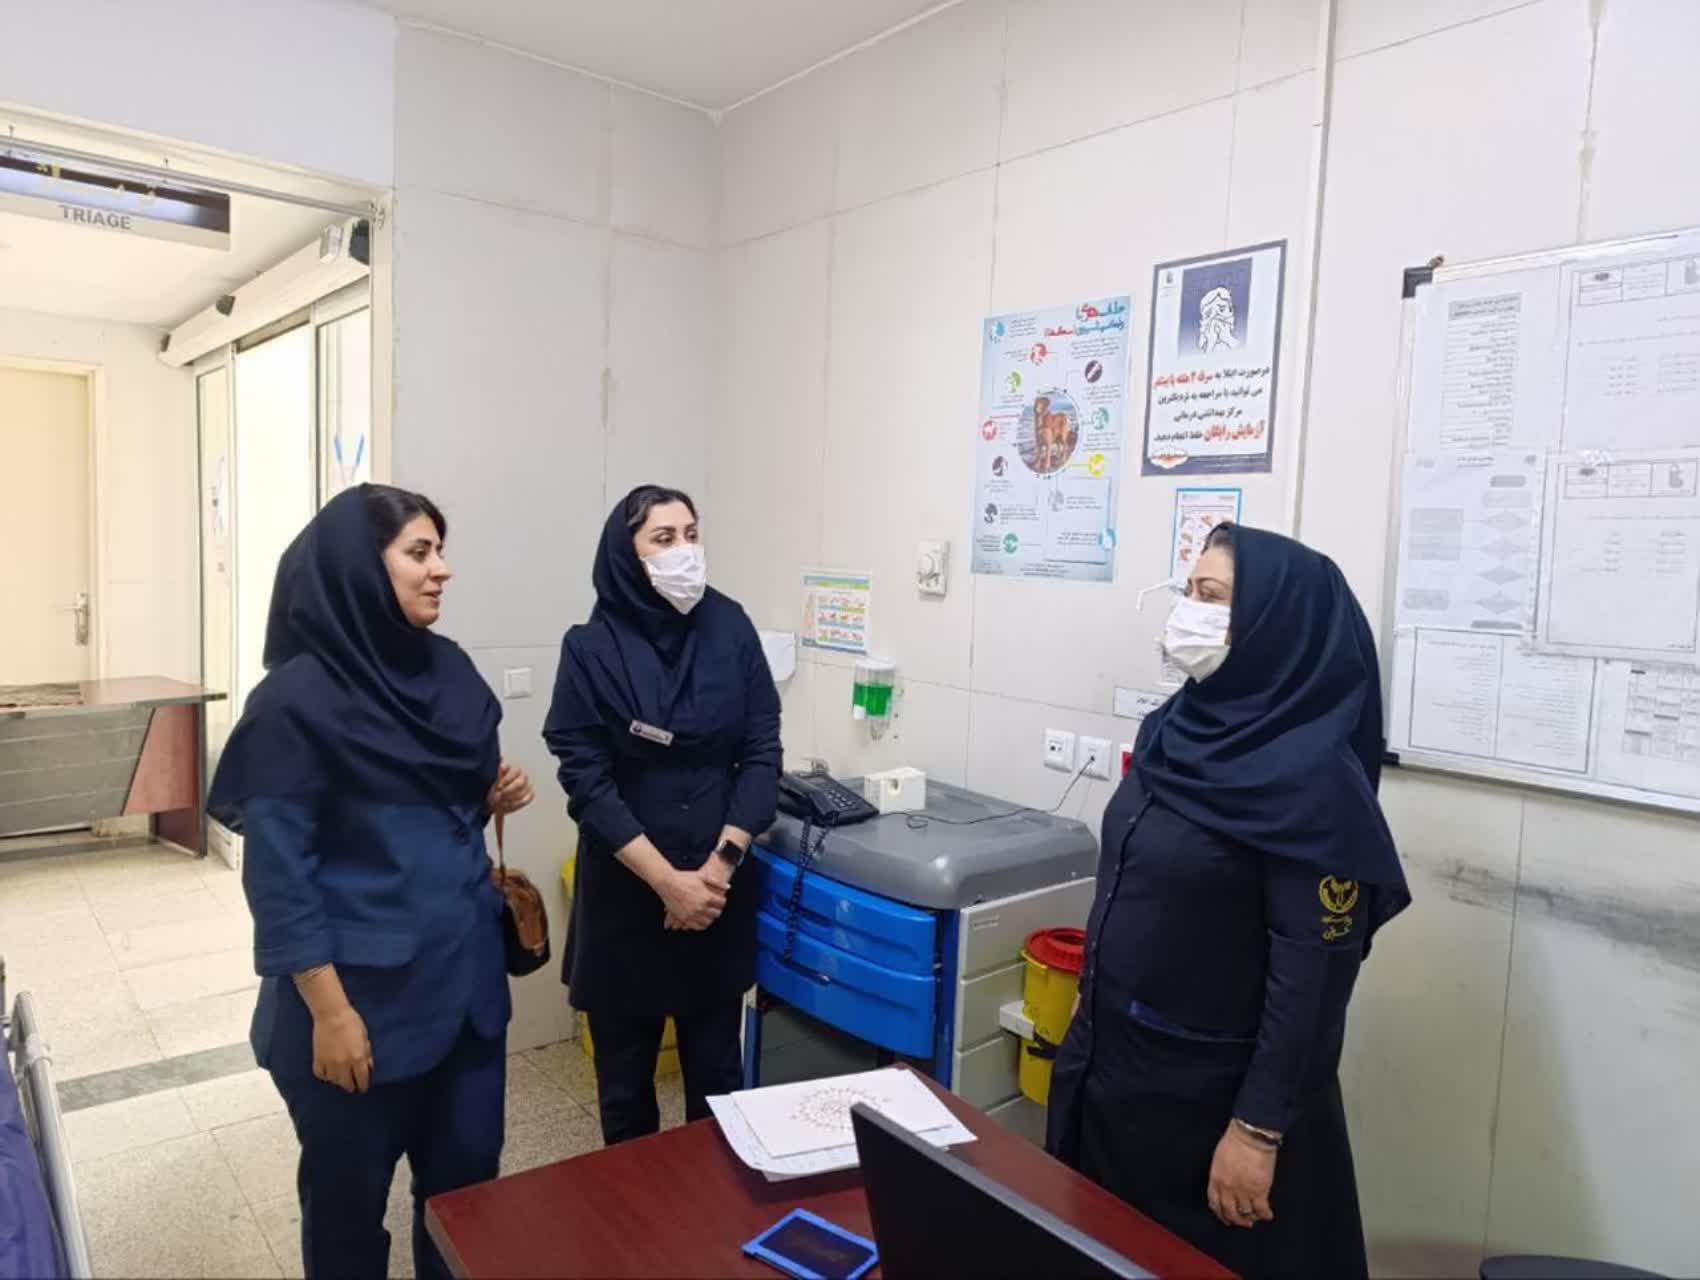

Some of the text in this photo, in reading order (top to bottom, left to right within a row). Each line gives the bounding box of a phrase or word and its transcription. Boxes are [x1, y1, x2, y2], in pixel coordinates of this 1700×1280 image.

[58, 204, 132, 230] TRIAGE
[1176, 373, 1190, 384] هفته
[1198, 370, 1213, 384] سرفه
[1215, 371, 1222, 379] به
[1223, 368, 1237, 377] ابتلا
[1199, 389, 1222, 400] مراجعه
[1173, 406, 1242, 422] مرکز بهداشتی درمانی
[1204, 424, 1232, 442] رایگان
[1231, 419, 1265, 440] آزمایش
[1171, 431, 1188, 442] انجام
